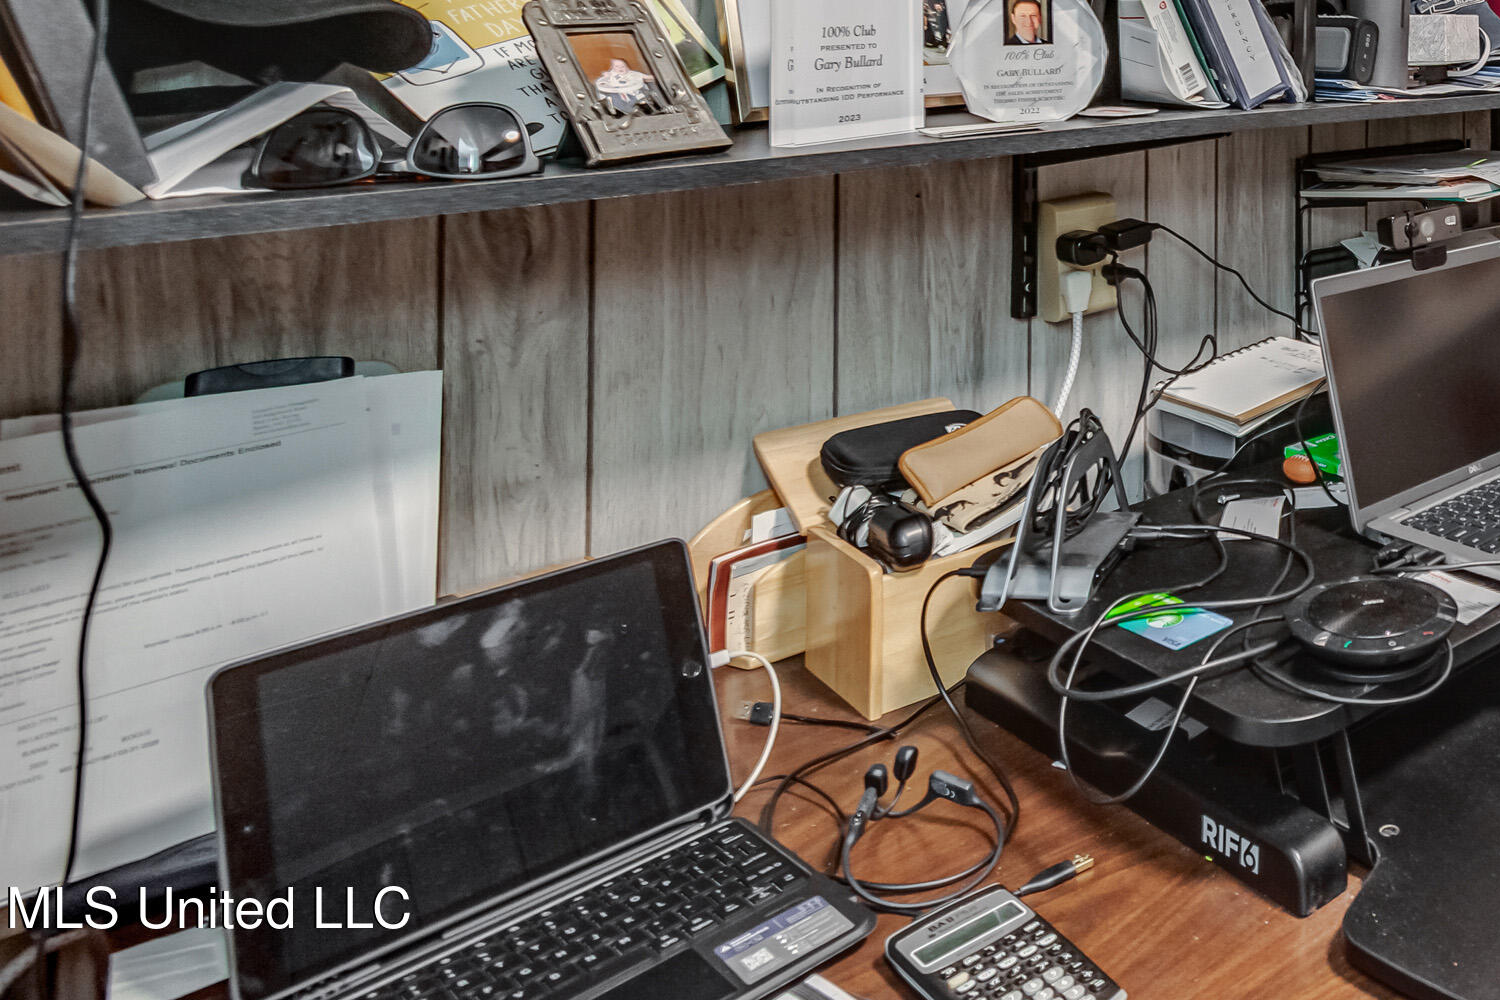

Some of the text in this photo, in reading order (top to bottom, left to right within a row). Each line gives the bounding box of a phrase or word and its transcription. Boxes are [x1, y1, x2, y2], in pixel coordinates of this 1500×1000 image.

[822, 24, 876, 39] 100% Club
[493, 46, 508, 59] IF
[820, 43, 866, 51] PRESENTED
[507, 56, 536, 71] ARE
[814, 54, 883, 72] Gary Bullard
[1023, 67, 1061, 77] BULLARD
[857, 90, 904, 100] PERFORMANCE
[838, 114, 861, 123] 2023
[179, 439, 281, 466] Documents Enclosed
